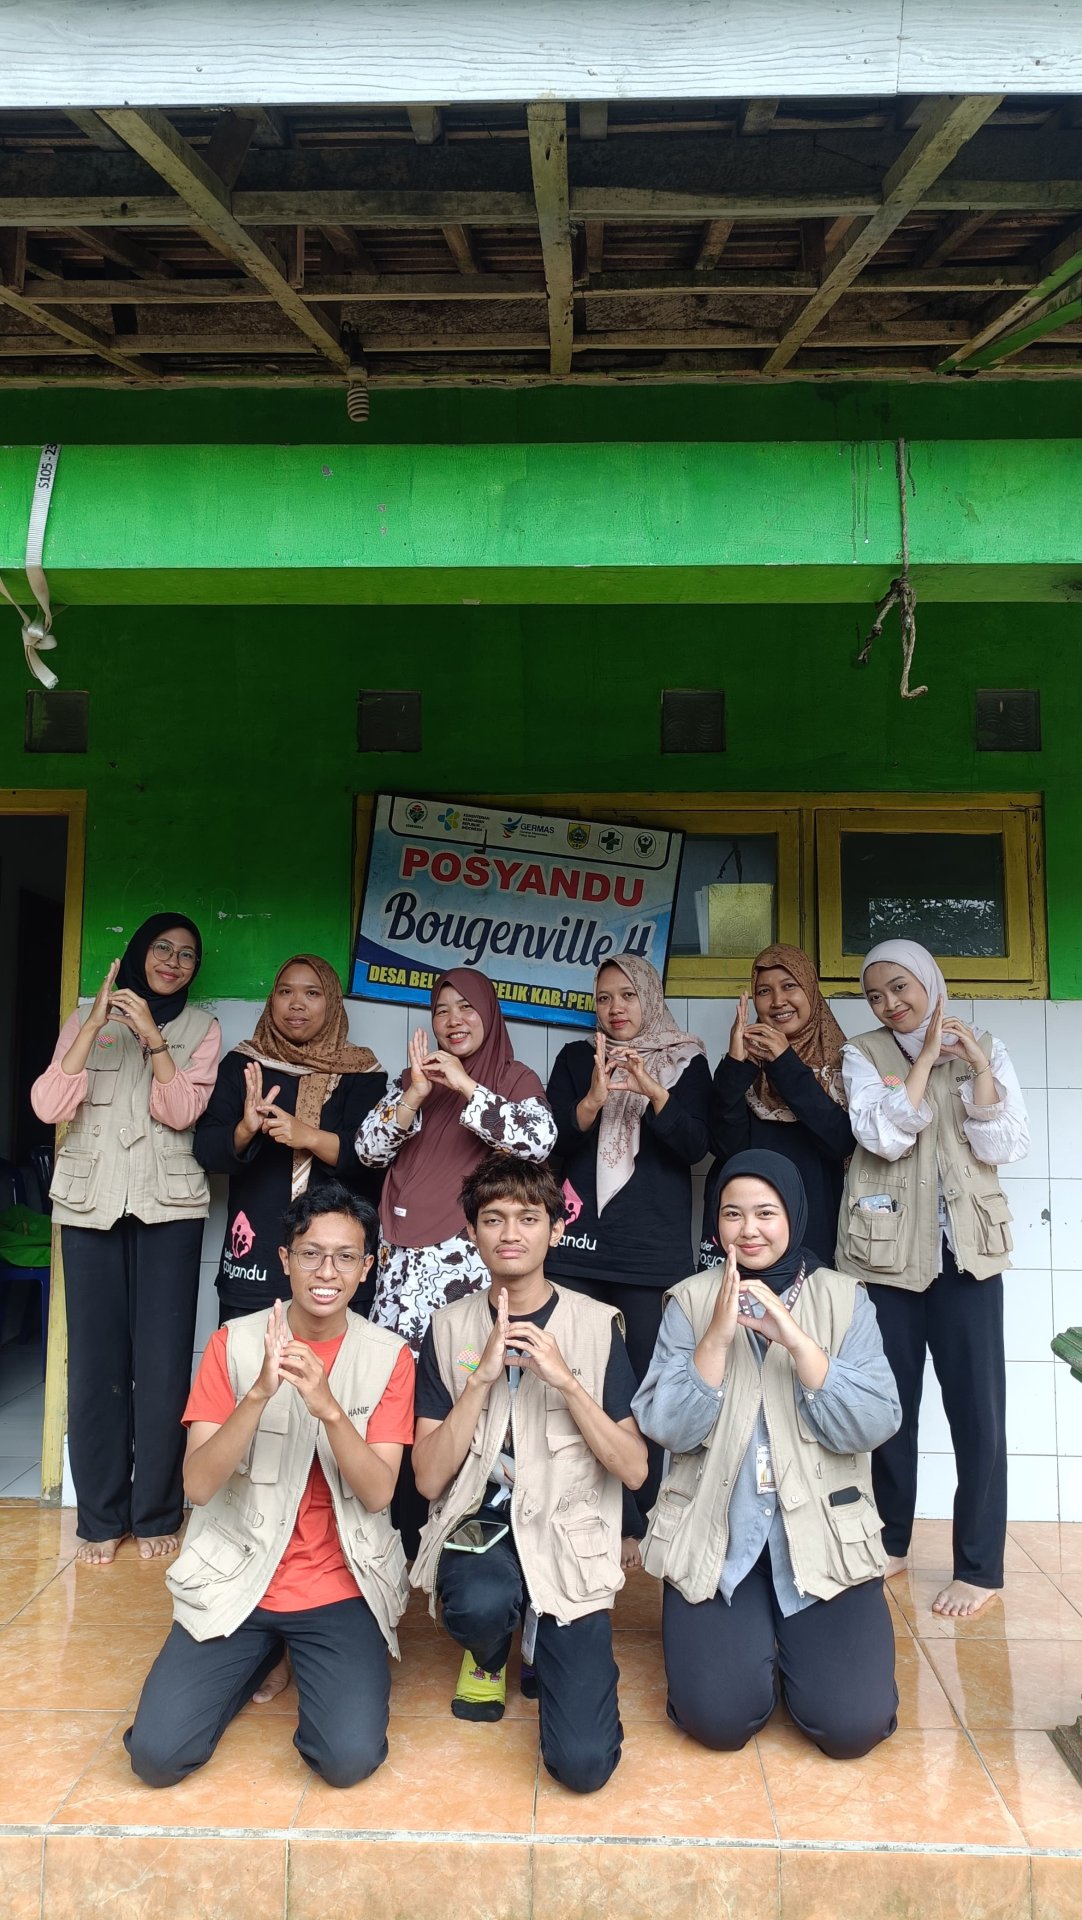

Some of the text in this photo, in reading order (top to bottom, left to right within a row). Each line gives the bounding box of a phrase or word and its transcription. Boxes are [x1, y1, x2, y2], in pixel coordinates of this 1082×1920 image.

[38, 463, 53, 489] S105
[520, 822, 555, 834] GERMAS
[402, 848, 644, 907] POSYANDU
[385, 891, 613, 967] Bougenville
[369, 965, 407, 986] DESA
[530, 987, 564, 1007] KAB.
[567, 992, 596, 1012] PEM
[558, 1233, 597, 1251] andu
[347, 1406, 370, 1418] HANIF
